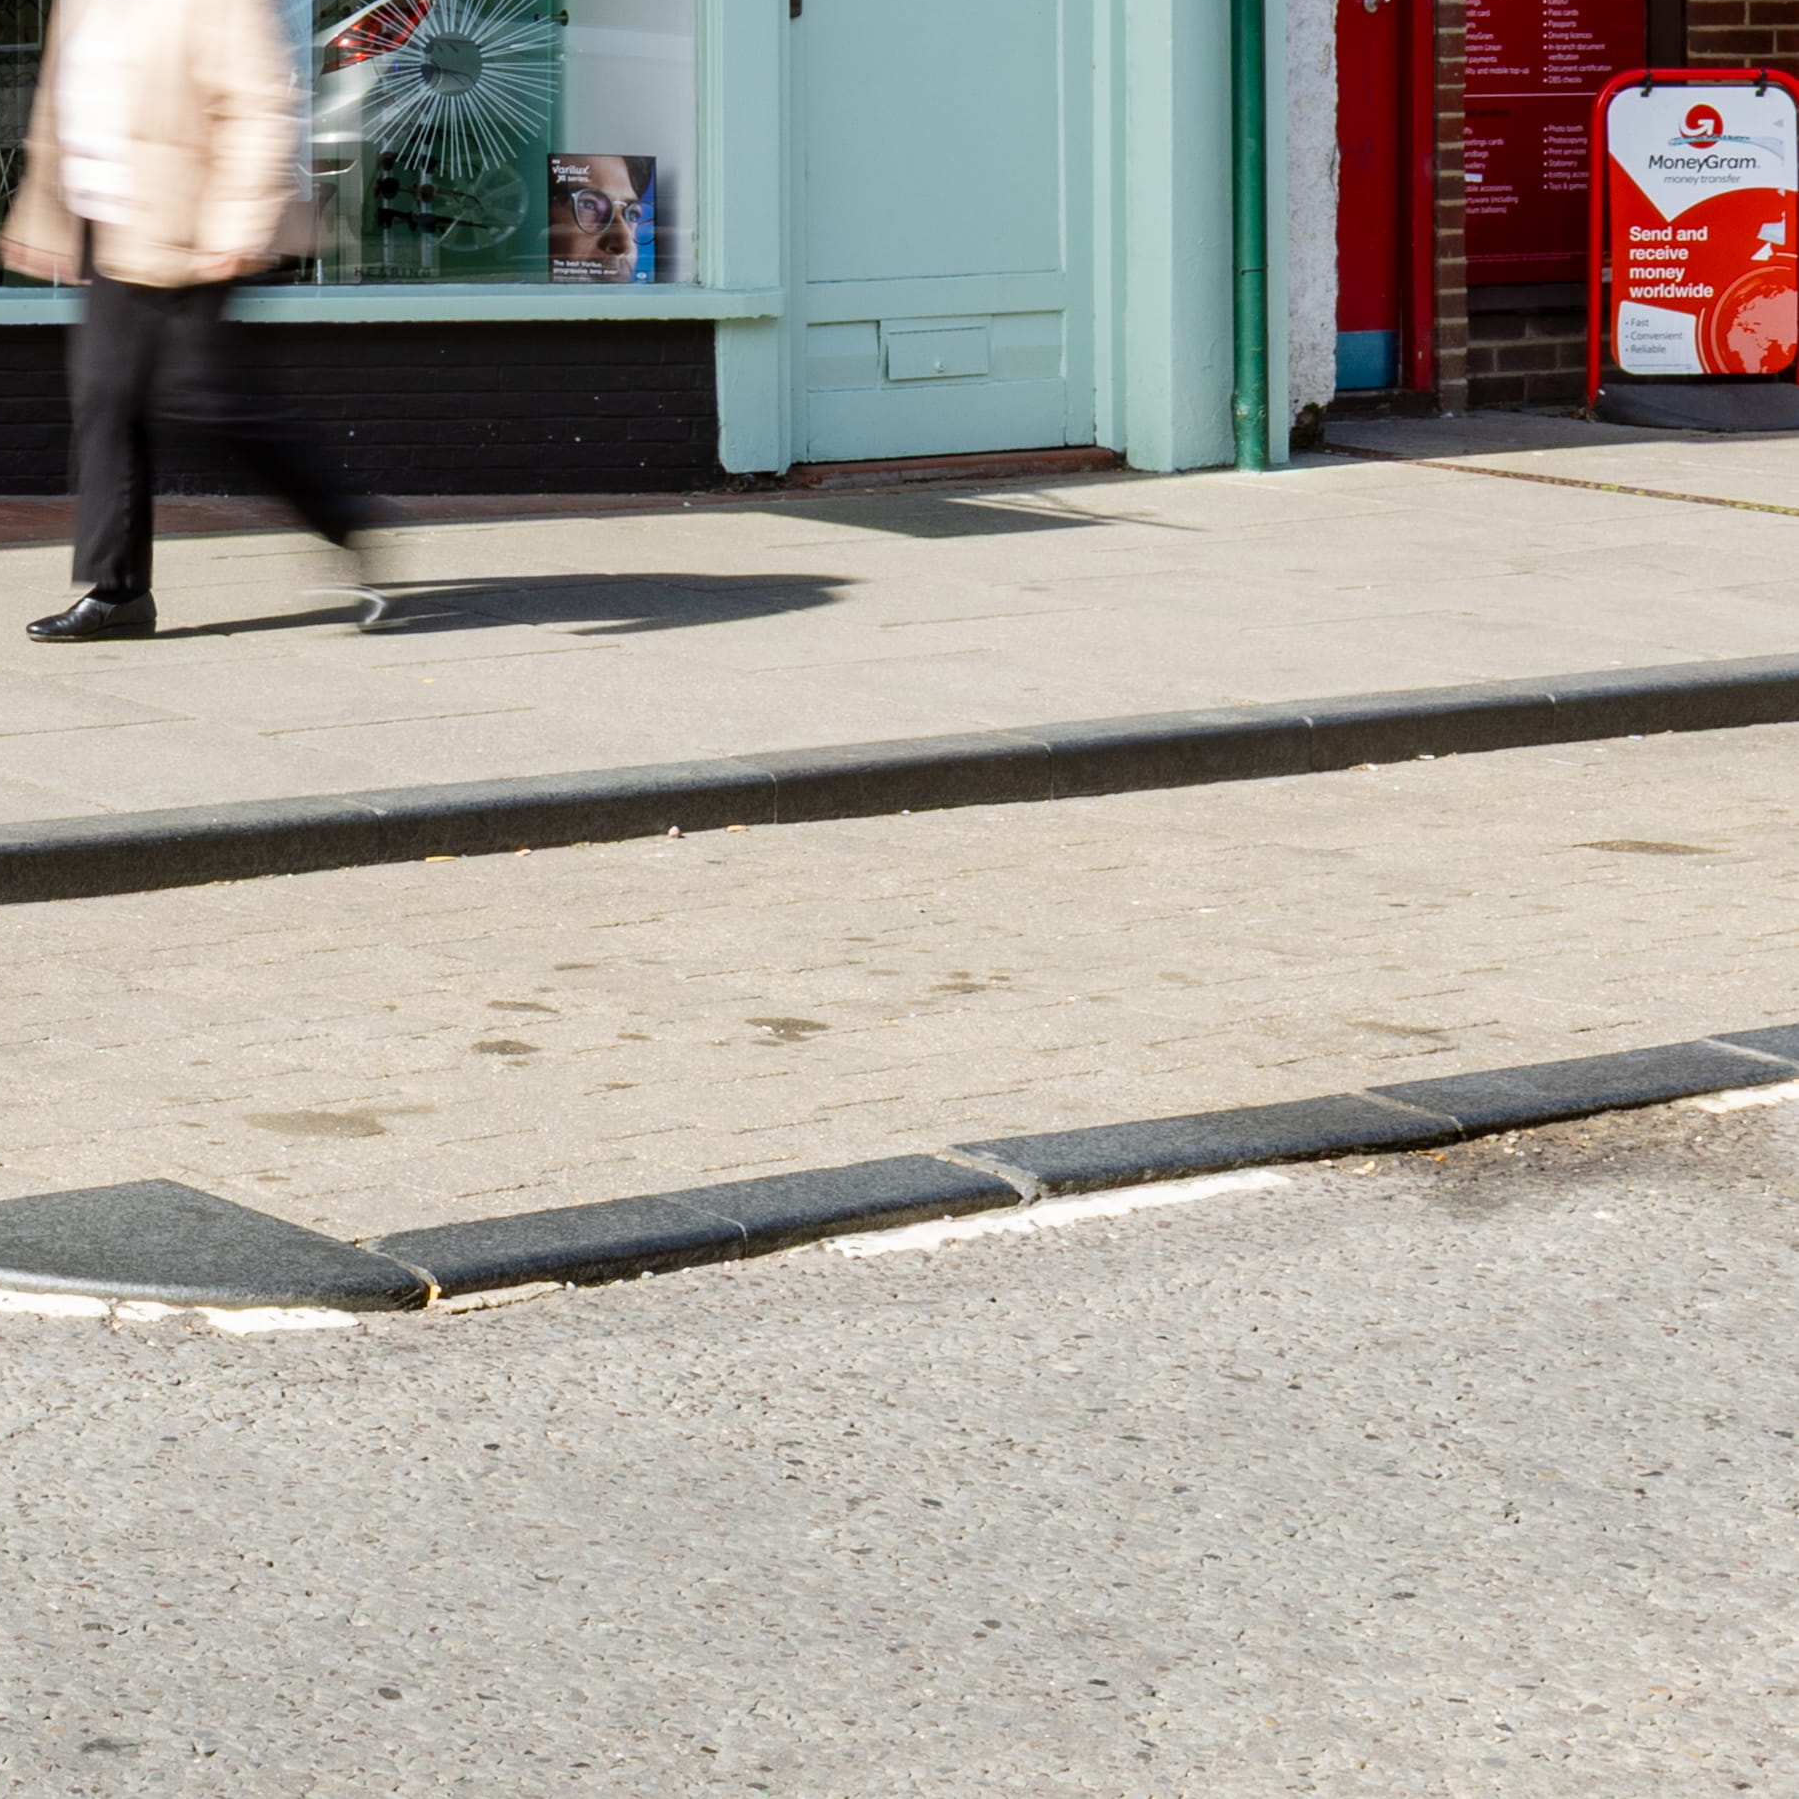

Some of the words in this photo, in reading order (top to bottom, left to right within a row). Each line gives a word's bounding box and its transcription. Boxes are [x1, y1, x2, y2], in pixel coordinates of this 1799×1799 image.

[1664, 174, 1699, 186] money
[1700, 173, 1740, 184] transfer
[1629, 225, 1672, 242] Send
[1676, 225, 1708, 241] and
[1629, 245, 1689, 261] receive
[553, 259, 565, 267] The
[1629, 265, 1685, 283] money
[1629, 283, 1714, 299] worldwide
[1630, 318, 1649, 328] Fast
[1630, 331, 1682, 341] Convenient
[1630, 344, 1666, 354] Reliable
